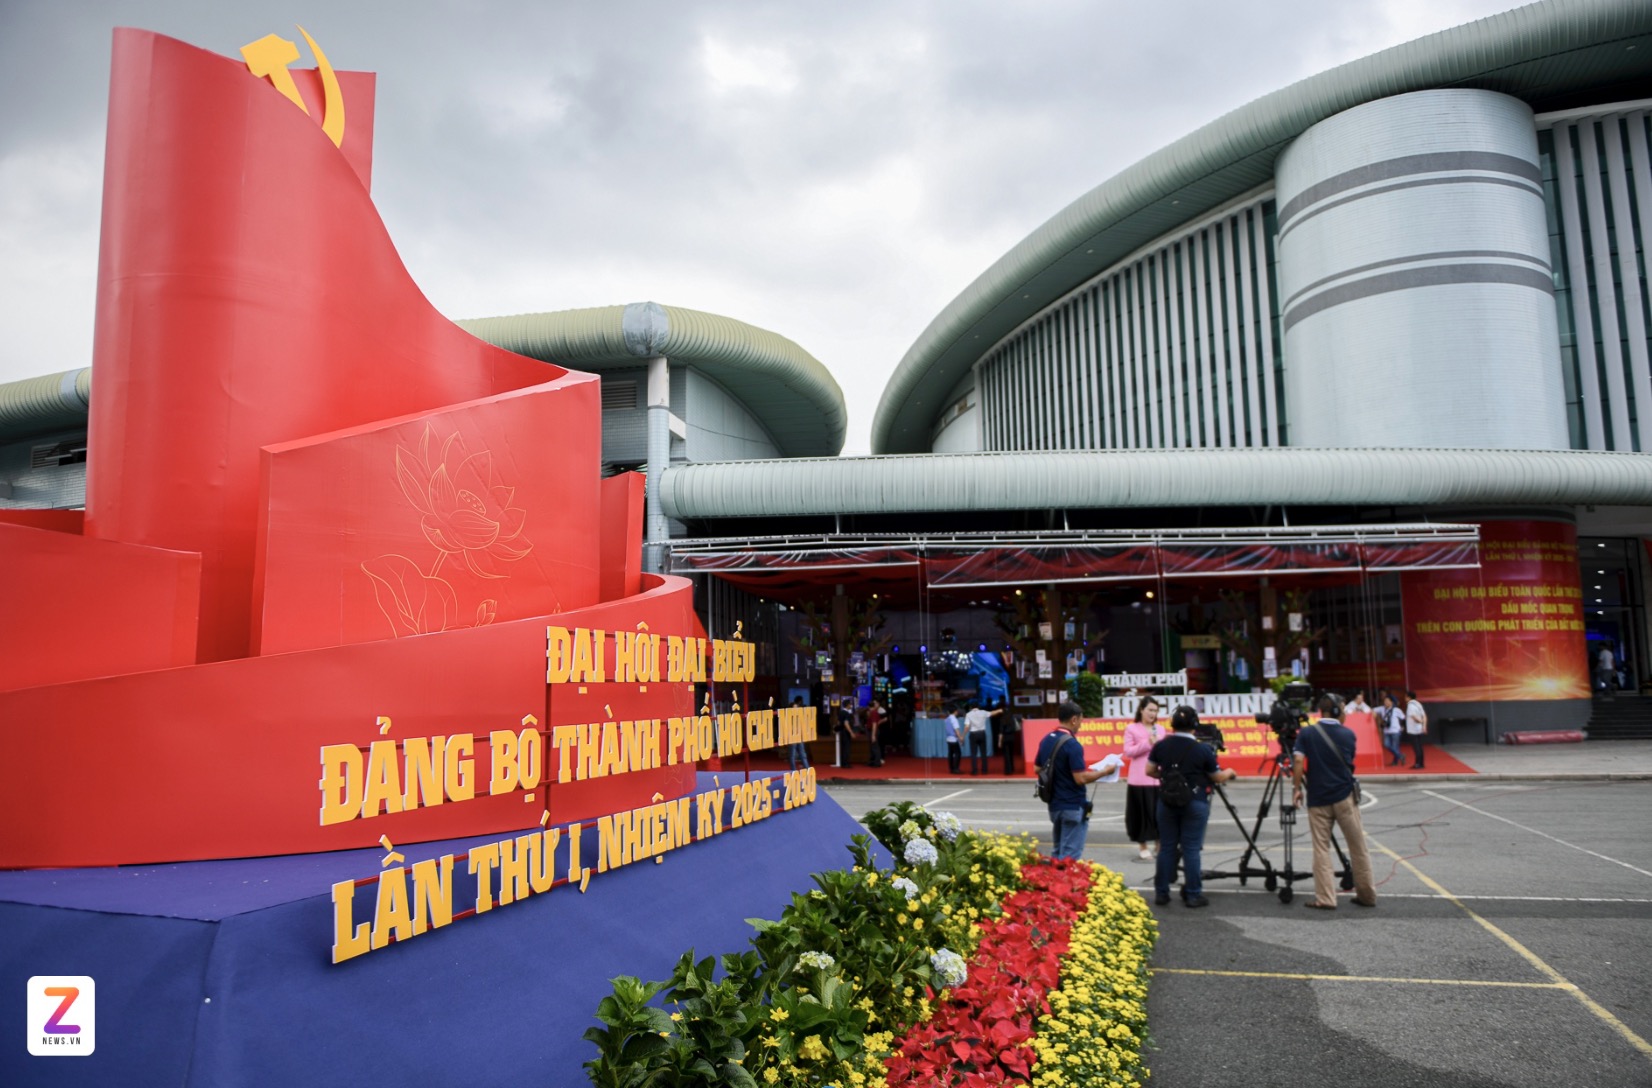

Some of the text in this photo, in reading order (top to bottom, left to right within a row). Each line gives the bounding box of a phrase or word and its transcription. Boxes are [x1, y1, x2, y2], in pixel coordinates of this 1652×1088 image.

[547, 620, 756, 694] ĐẠI HỘI ĐẠI BIỂU
[319, 690, 817, 826] ĐẢNG BỘ THÀNH PHỐ HỒ CHÍ MINH
[332, 834, 454, 964] LẦN
[468, 809, 561, 913] THỨ
[568, 822, 591, 894] I,
[598, 791, 691, 873] NHIỆM
[696, 775, 726, 840] KỲ
[731, 777, 772, 828] 2025
[784, 766, 817, 811] 2030
